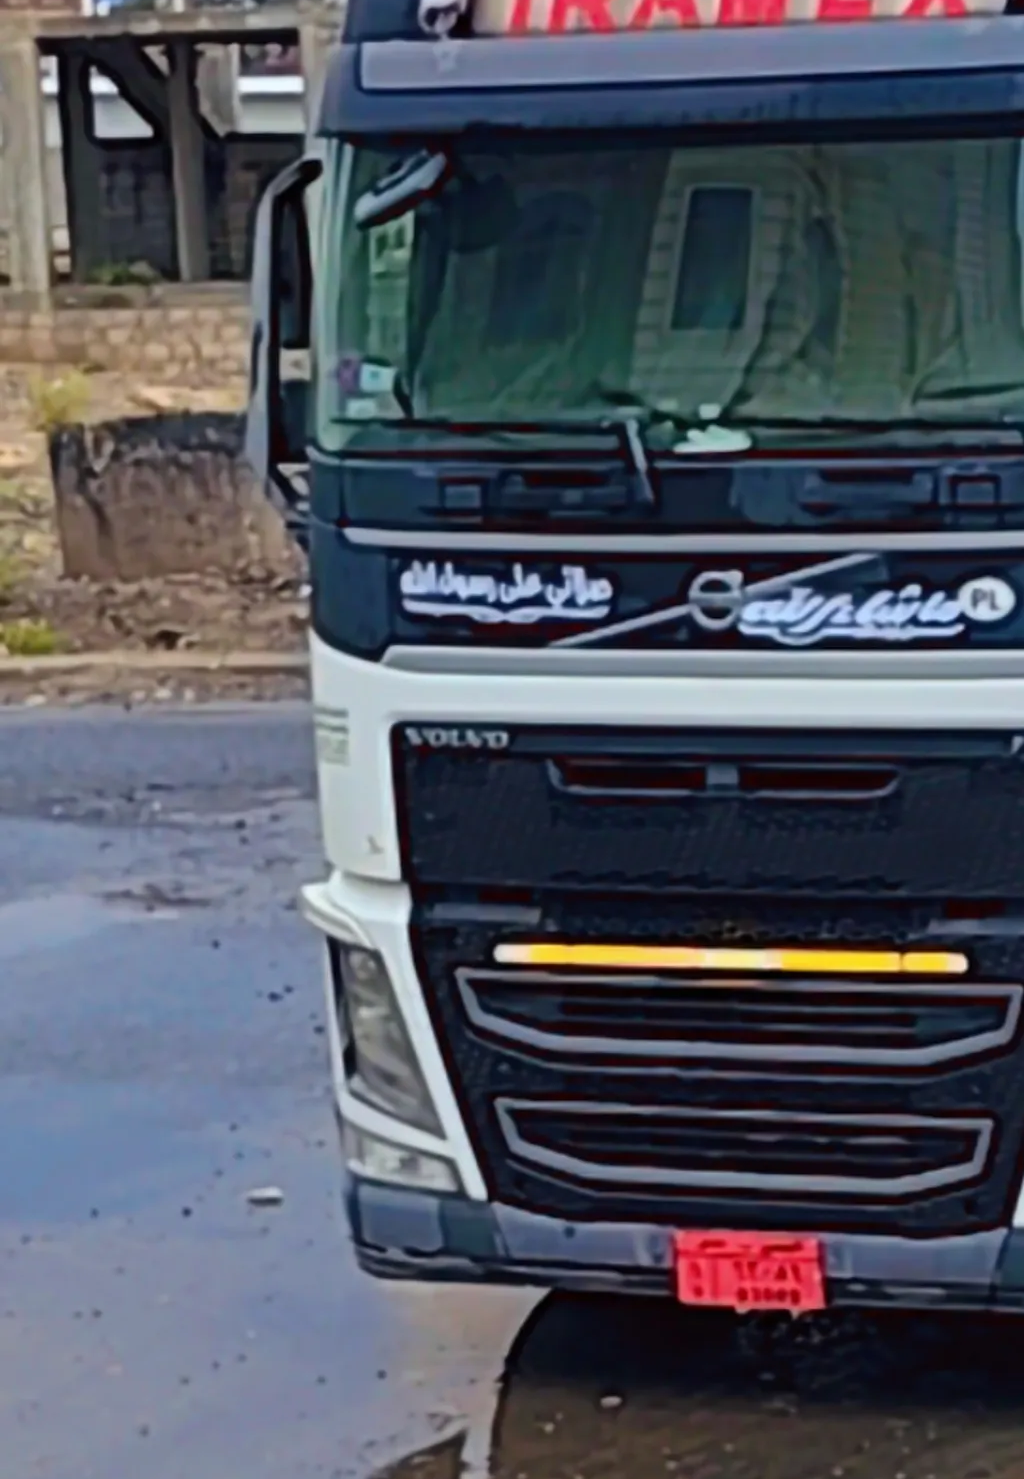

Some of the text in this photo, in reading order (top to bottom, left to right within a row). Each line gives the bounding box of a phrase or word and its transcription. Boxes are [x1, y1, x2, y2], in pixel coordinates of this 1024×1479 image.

[400, 559, 436, 595] الله
[969, 587, 999, 612] PL
[404, 726, 510, 750] VOLVO
